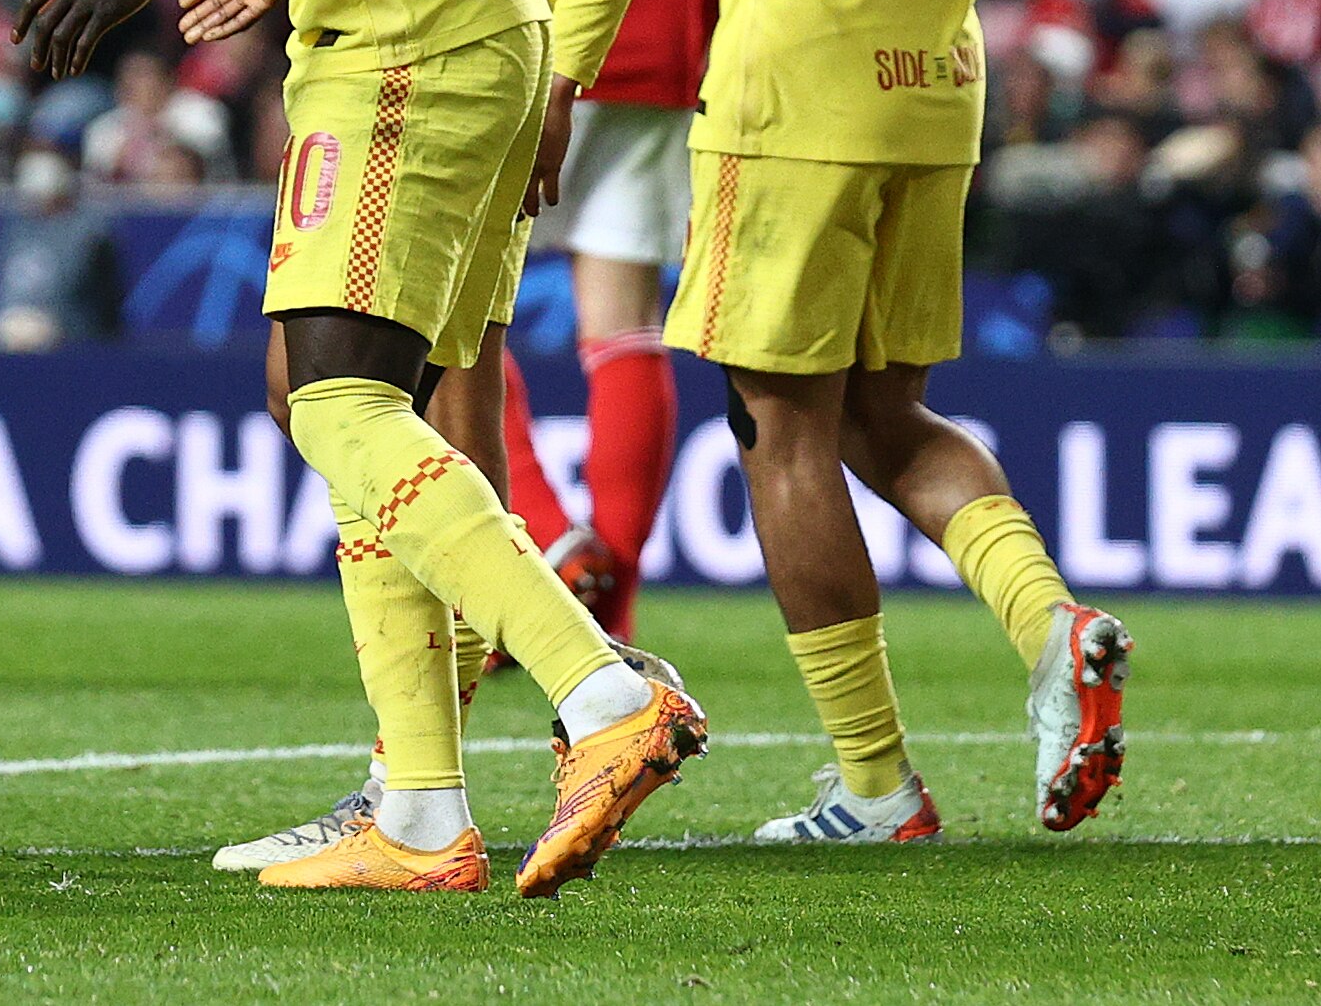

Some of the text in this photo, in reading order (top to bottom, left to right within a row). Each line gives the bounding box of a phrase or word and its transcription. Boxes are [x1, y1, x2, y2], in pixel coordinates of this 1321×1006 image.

[874, 47, 931, 91] SIDE
[275, 131, 341, 233] 10
[1058, 422, 1321, 591] LEA
